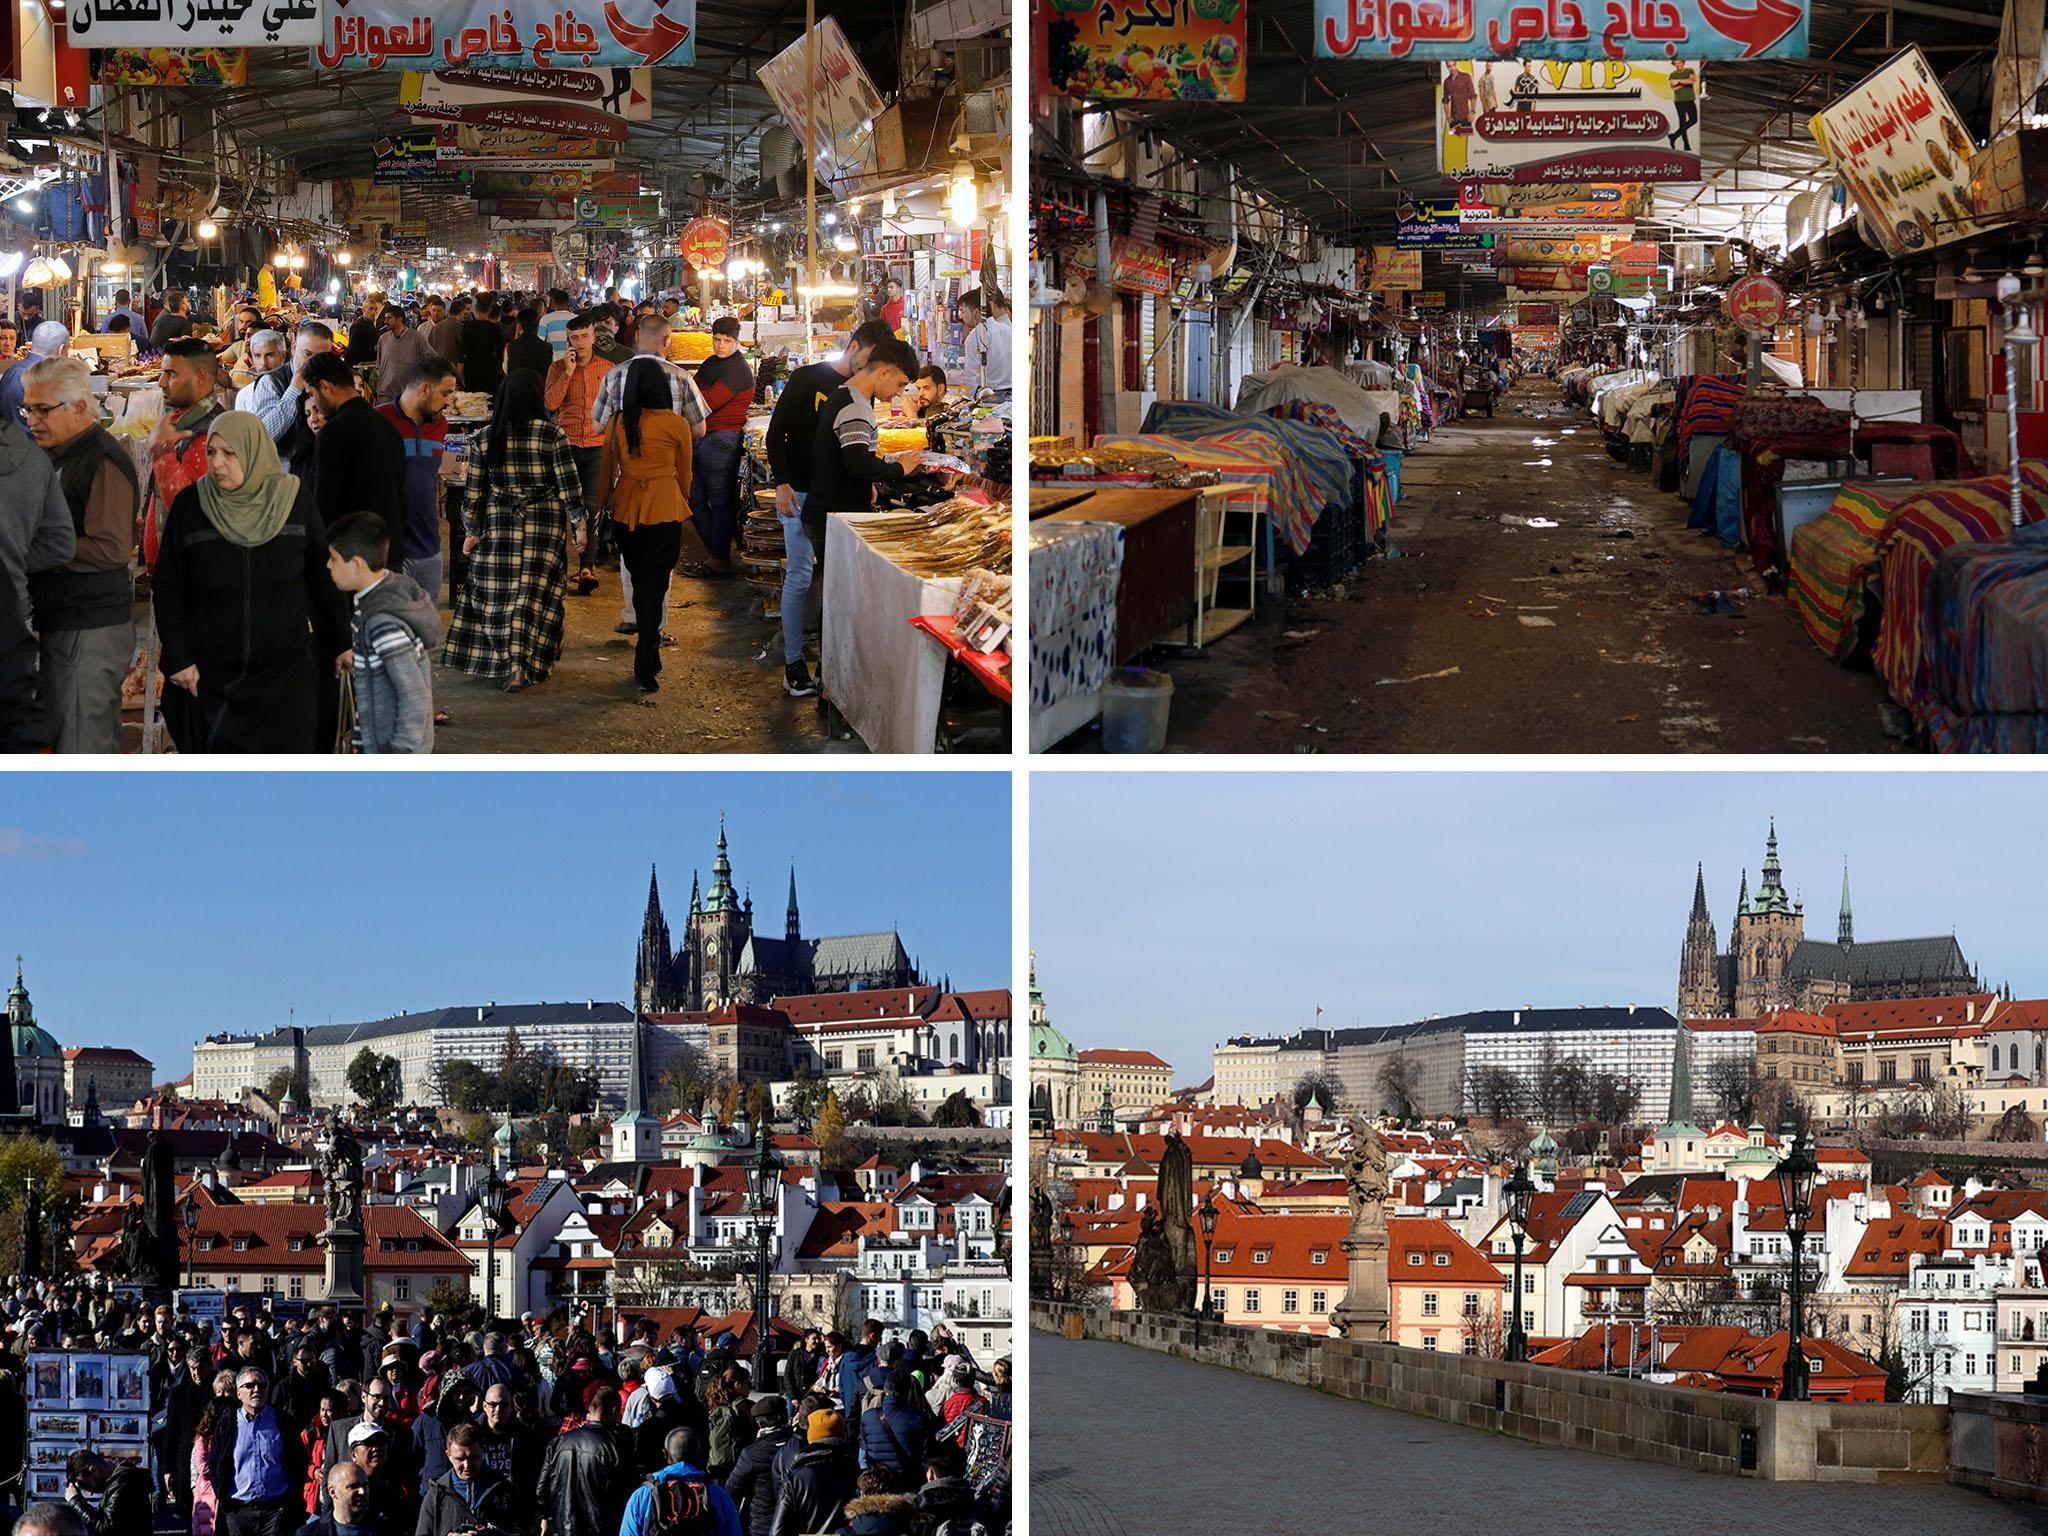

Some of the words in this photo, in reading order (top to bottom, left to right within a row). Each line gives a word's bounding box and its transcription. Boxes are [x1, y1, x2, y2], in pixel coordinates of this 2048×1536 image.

[317, 15, 434, 68] للعوائل
[443, 9, 523, 65] خاص
[533, 10, 600, 67] جناح
[522, 69, 560, 89] الرجالية
[562, 73, 596, 93] للألبسة
[1542, 59, 1627, 91] VIP
[404, 98, 428, 113] مفرد
[437, 100, 462, 118] جملة
[1898, 76, 1933, 139] مطعم
[1484, 115, 1524, 136] الجاهزة
[1526, 113, 1575, 136] والشبابية
[1576, 113, 1620, 135] الرجالية
[1621, 112, 1660, 134] للألبسة
[1451, 164, 1476, 182] مفرد
[1488, 163, 1515, 180] جملة
[1739, 293, 1777, 312] نبيل
